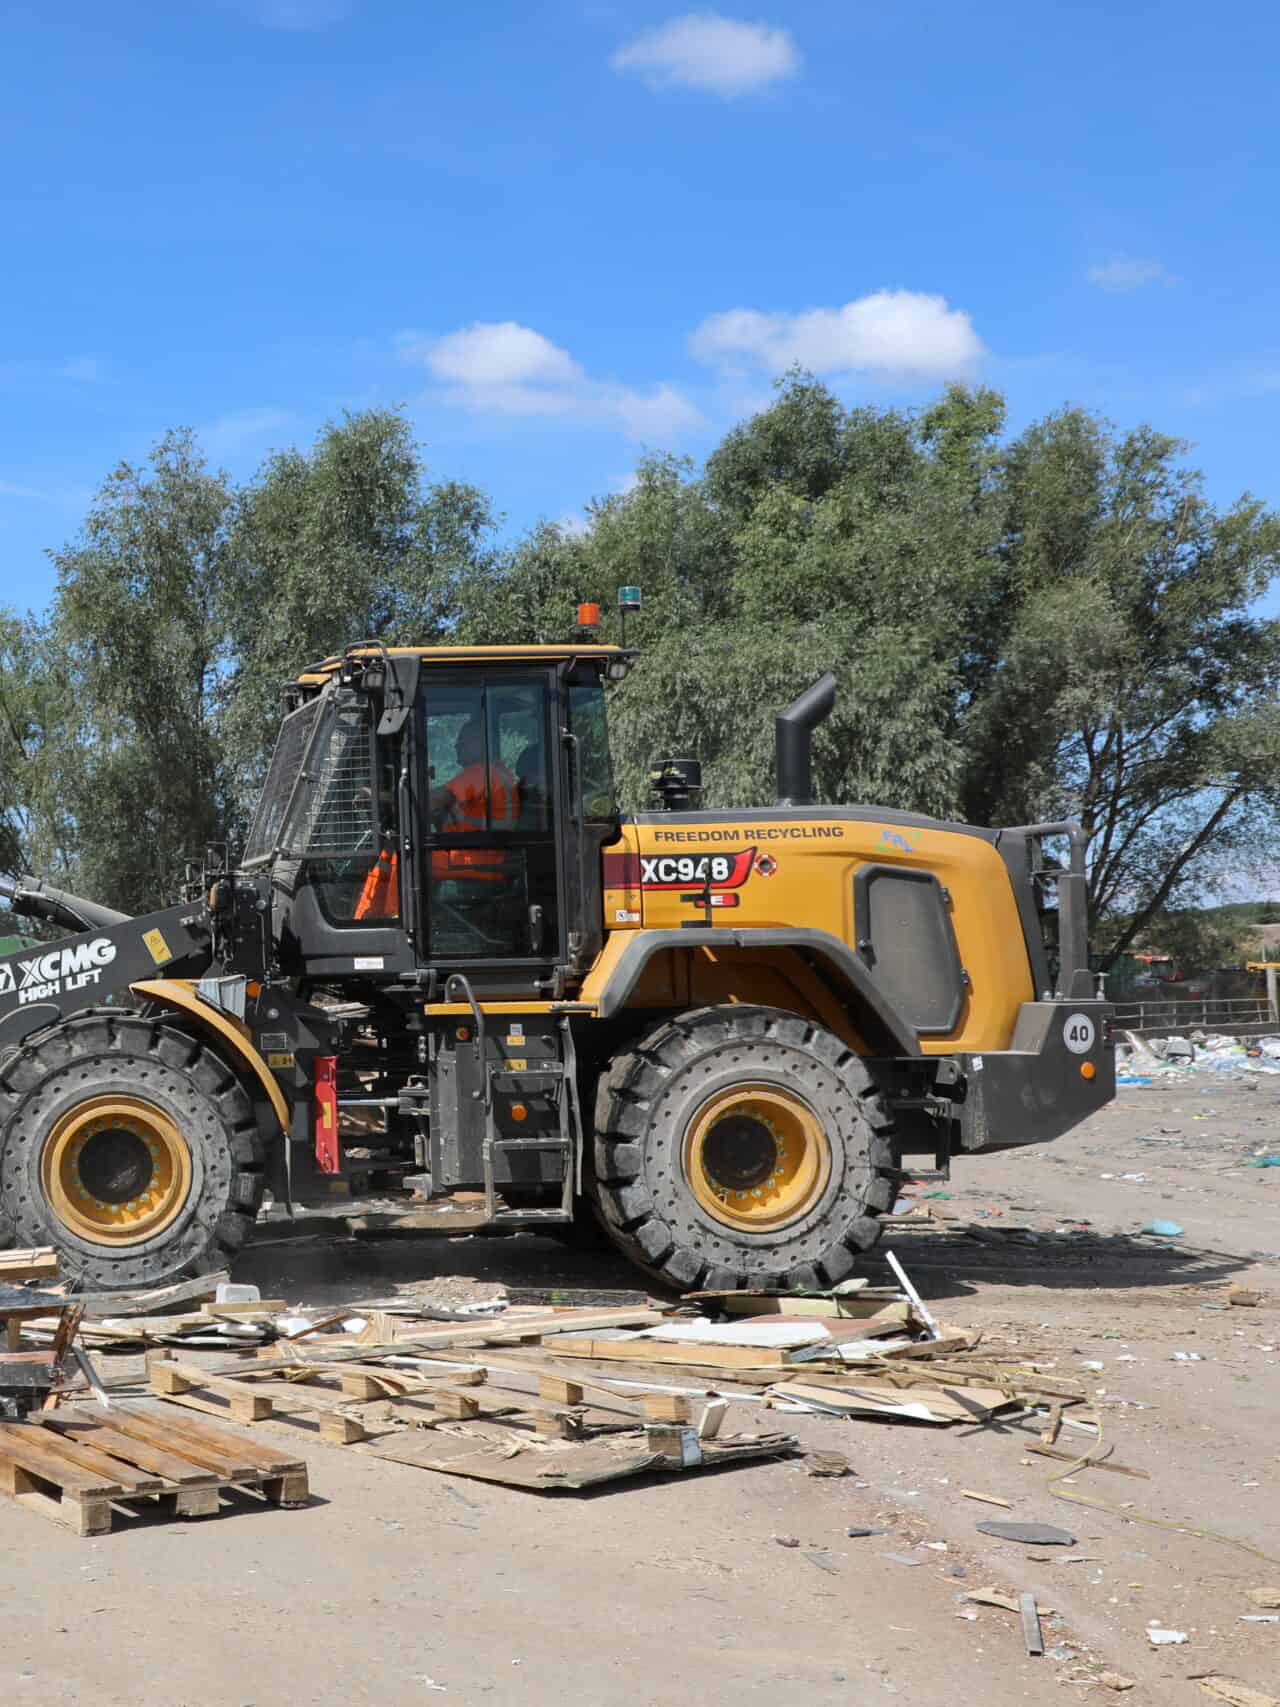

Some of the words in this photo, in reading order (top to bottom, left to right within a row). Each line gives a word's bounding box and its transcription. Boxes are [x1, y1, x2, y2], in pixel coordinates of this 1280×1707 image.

[654, 830, 740, 842] FREEDOM
[744, 826, 844, 840] RECYCLING
[17, 938, 117, 989] XCMG
[18, 980, 61, 1004] HIGH
[65, 967, 102, 991] LIFT
[1069, 1025, 1089, 1043] 40
